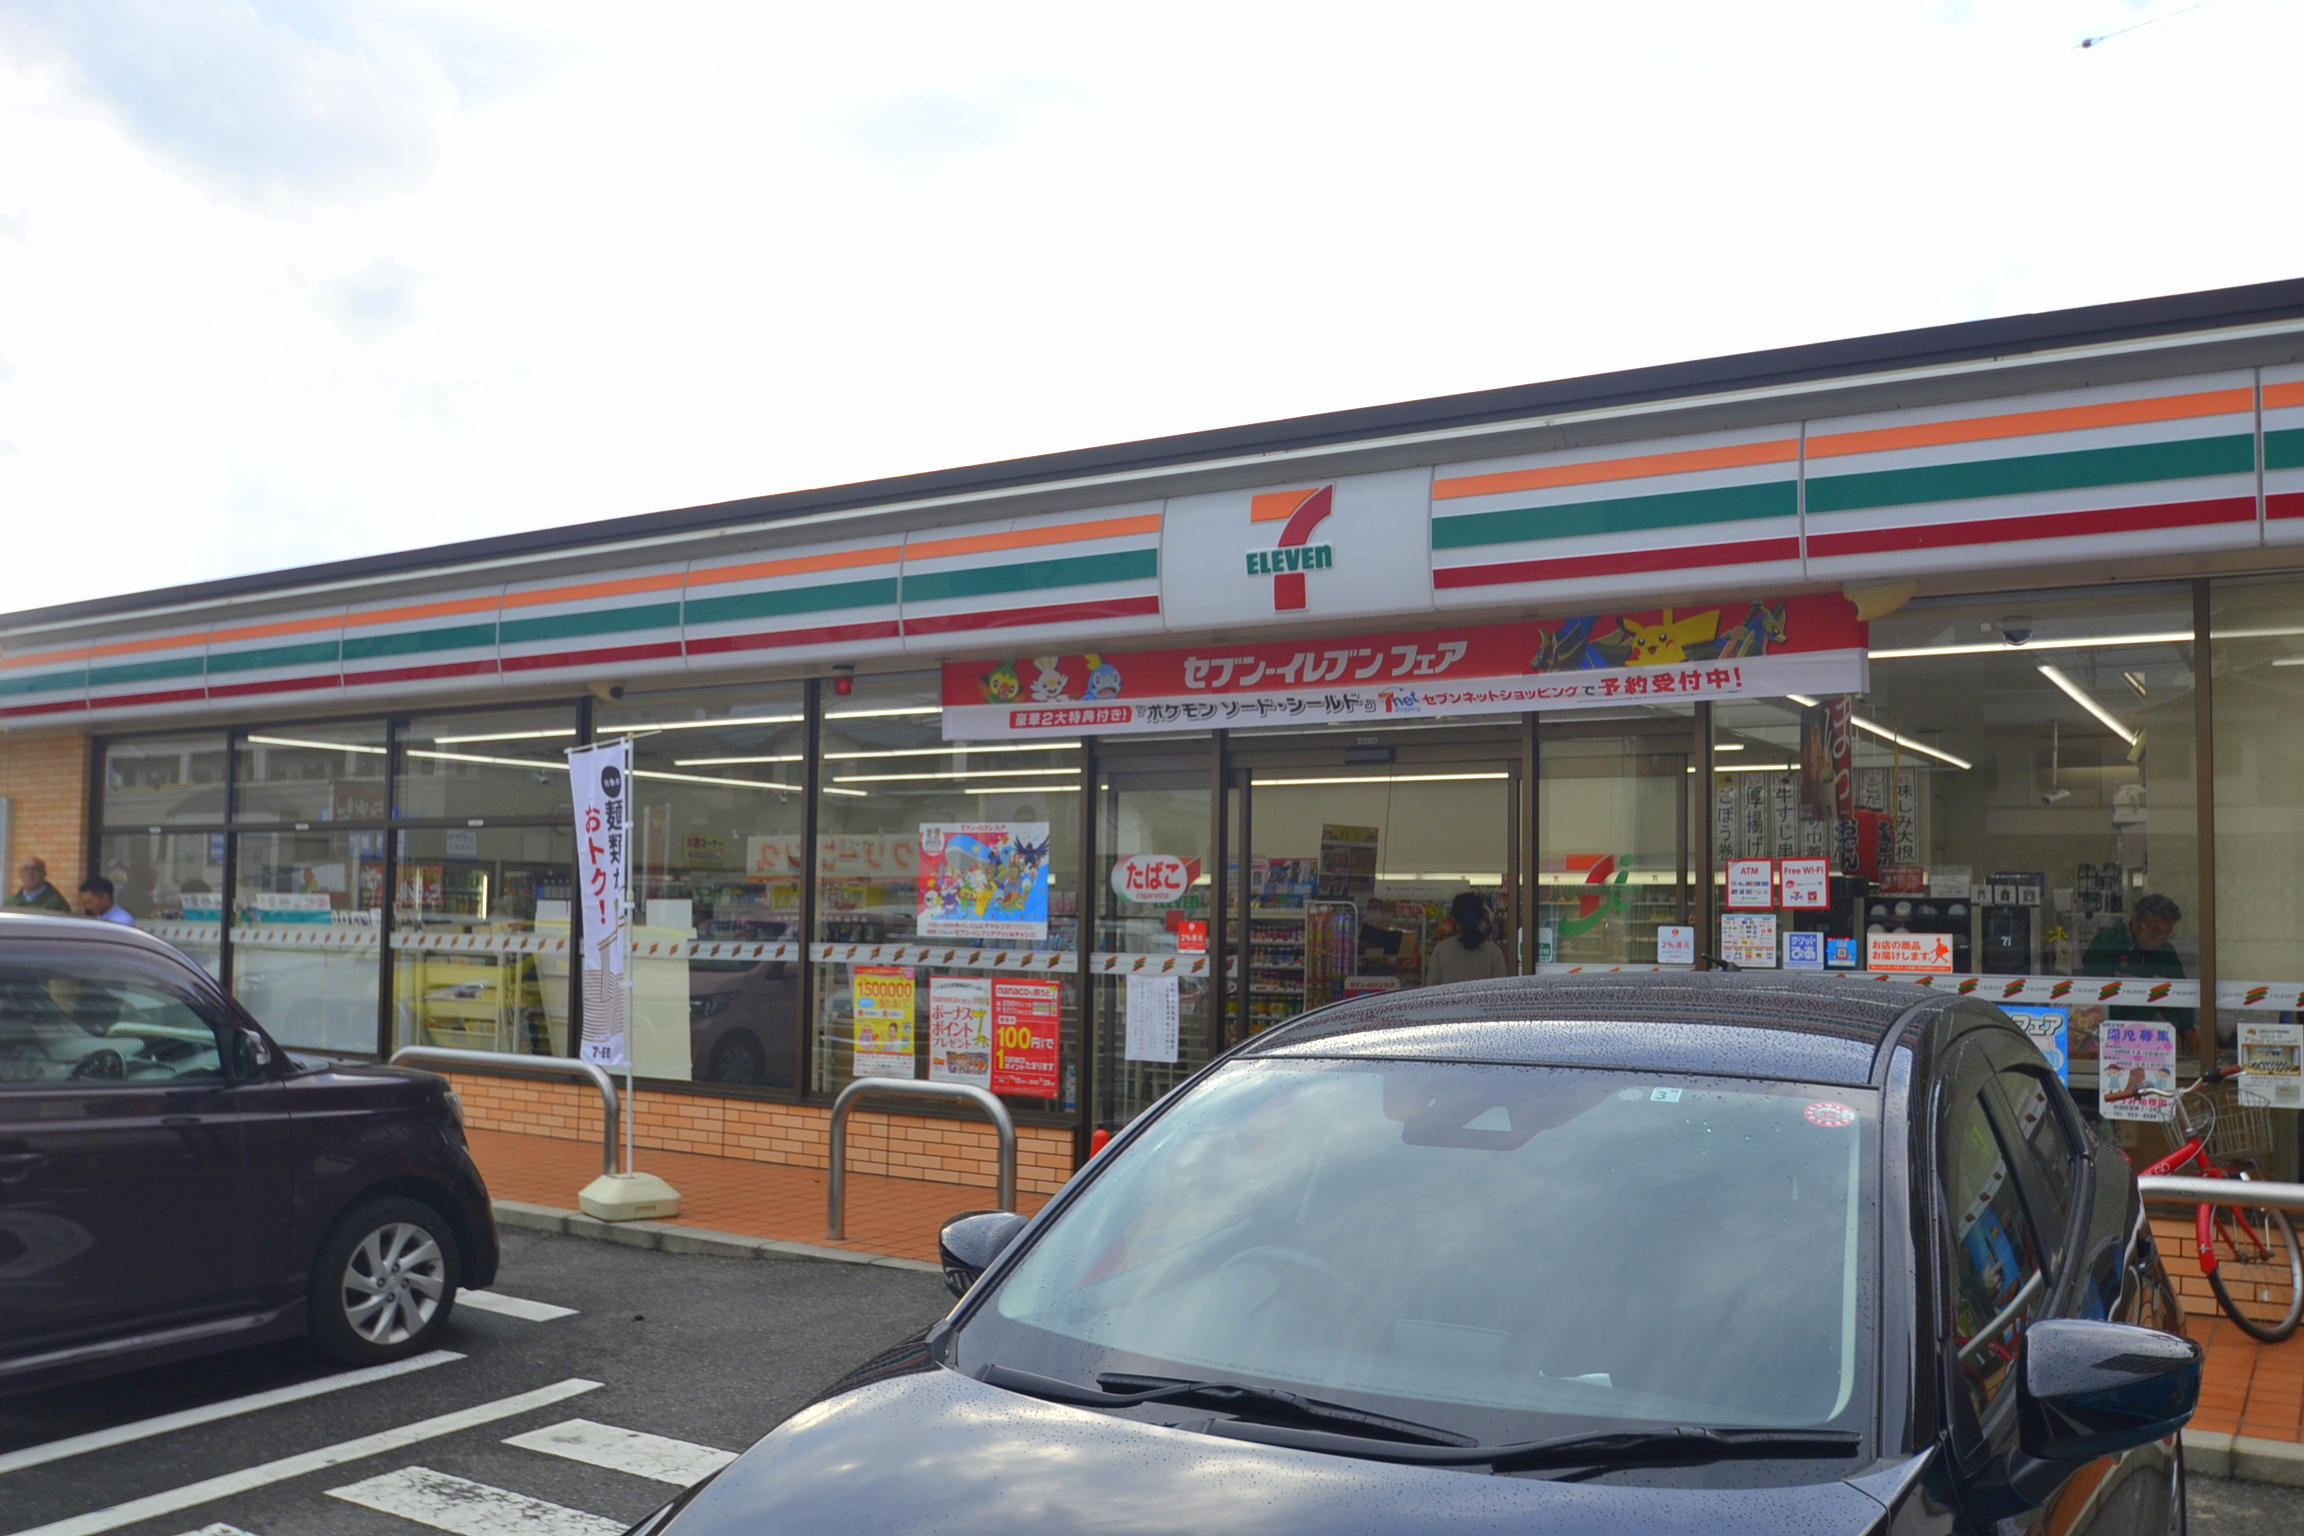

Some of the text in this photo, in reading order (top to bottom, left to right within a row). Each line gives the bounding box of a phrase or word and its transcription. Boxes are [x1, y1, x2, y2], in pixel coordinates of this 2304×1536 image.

[1250, 484, 1333, 611] 7
[1392, 640, 1468, 677] フェア
[1599, 667, 1743, 696] 予約受付中!
[1015, 708, 1128, 727] 豪華2大特典付き!
[585, 805, 608, 925] おトク!
[1740, 867, 1759, 875] ATM
[1784, 866, 1824, 875] Free Wi-Fi
[1127, 861, 1181, 890] たばこ
[1872, 940, 1921, 951] お店の商品
[932, 1005, 973, 1020] ボーナス
[932, 1021, 973, 1038] ポイント
[1655, 1090, 1667, 1099] 3
